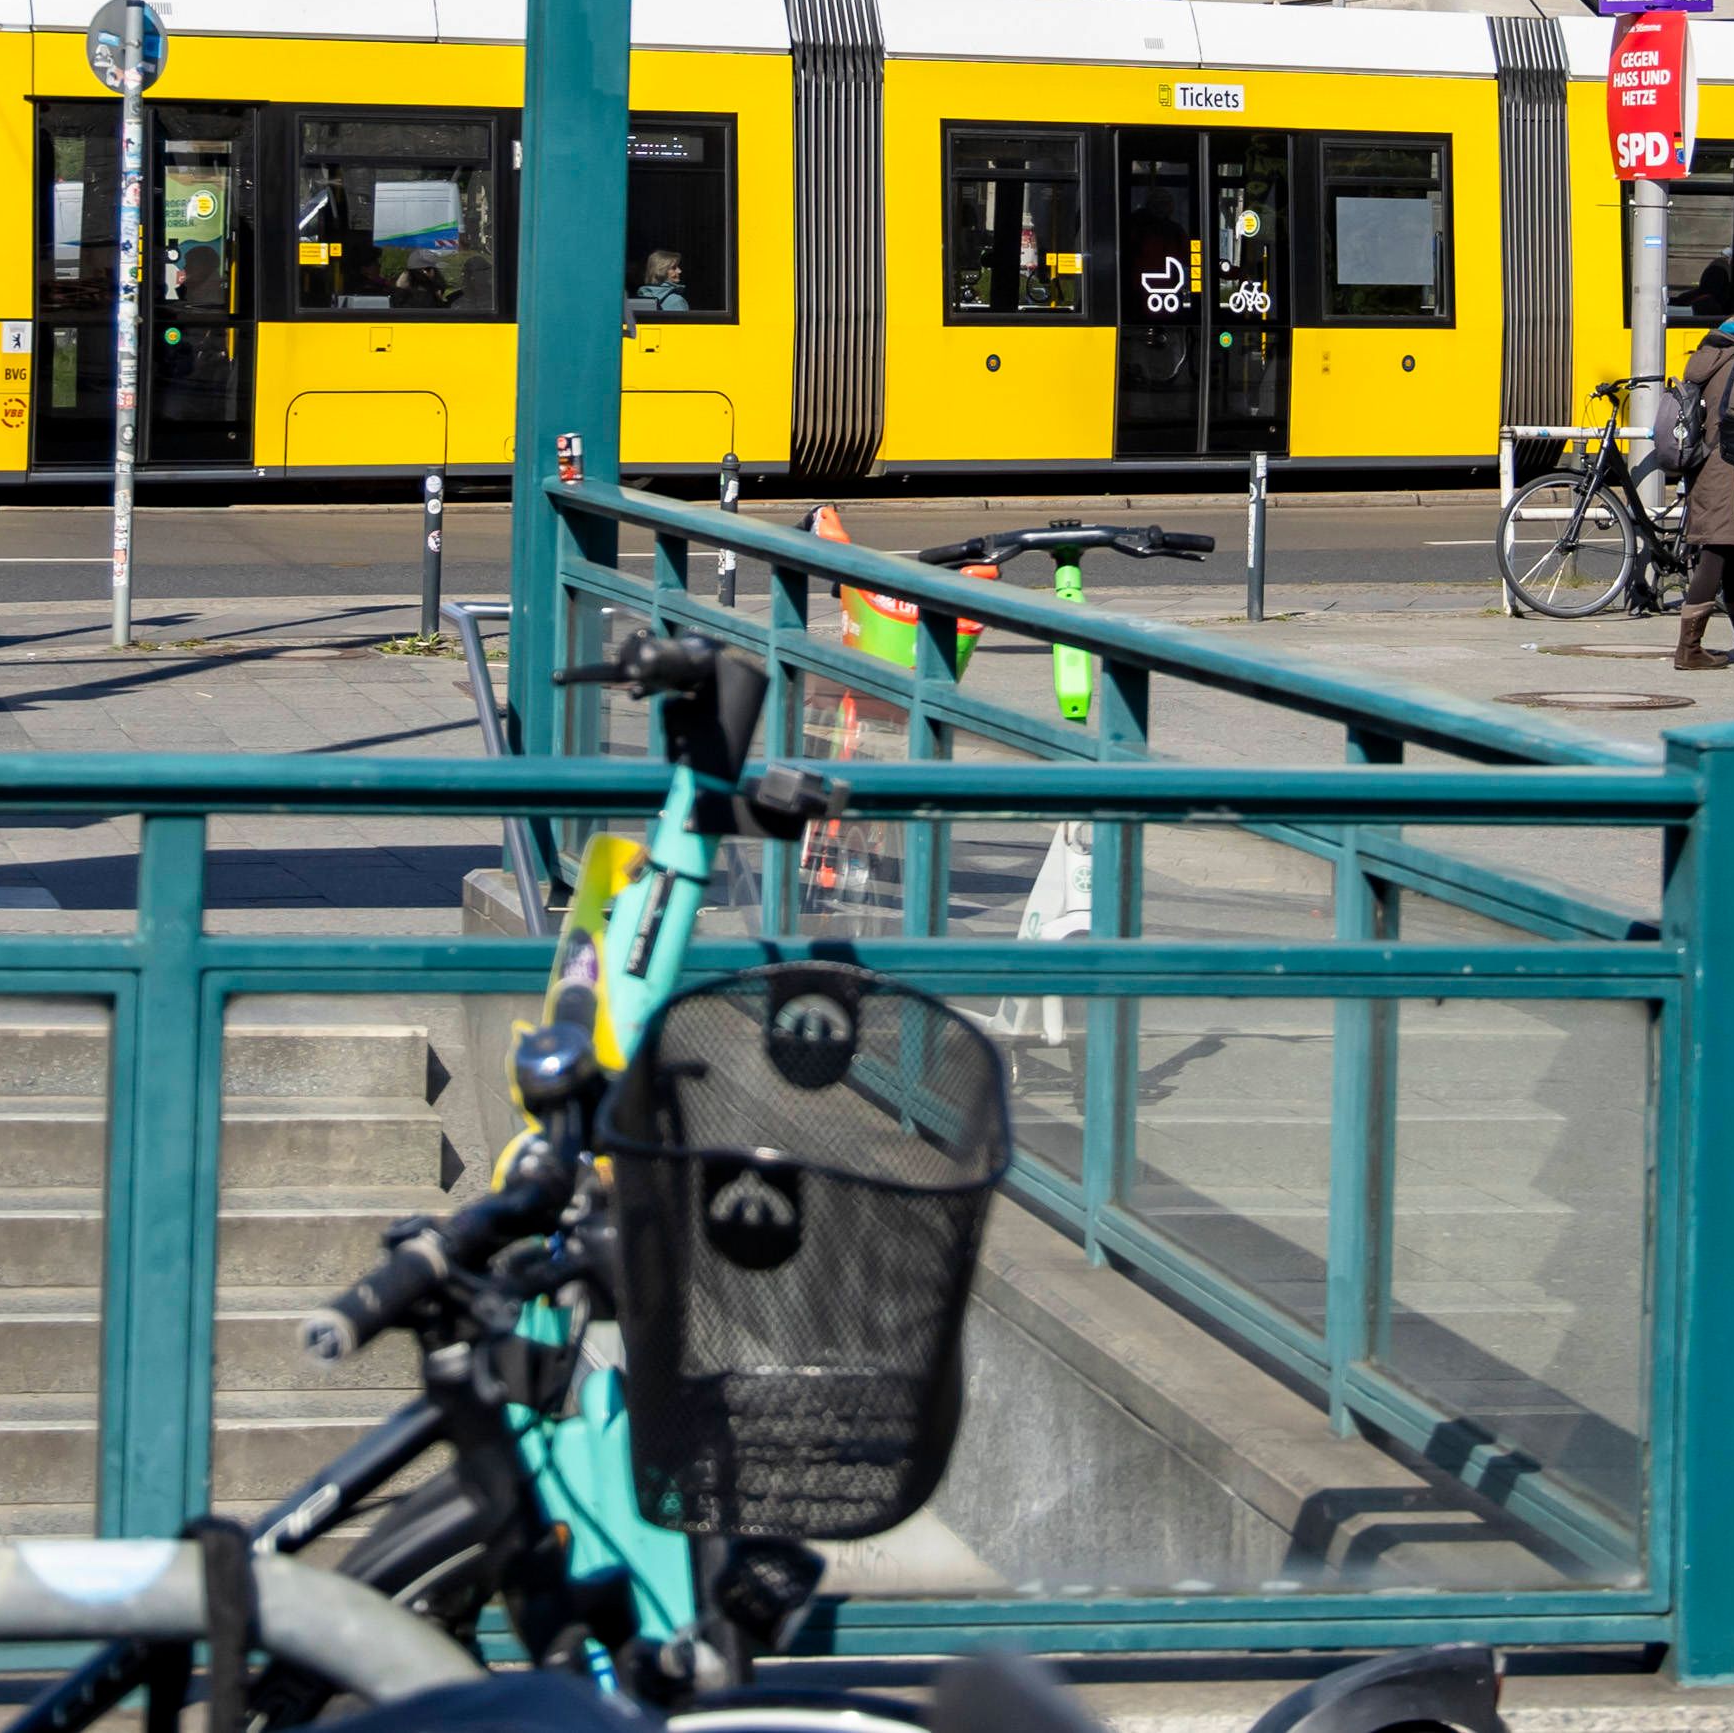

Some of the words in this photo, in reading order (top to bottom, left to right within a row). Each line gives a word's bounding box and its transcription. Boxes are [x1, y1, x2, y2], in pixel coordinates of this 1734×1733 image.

[1620, 50, 1660, 69] GEGEN
[1613, 70, 1640, 88] HASS
[1641, 69, 1671, 86] UND
[1179, 86, 1240, 109] Tickets
[1621, 89, 1657, 106] HETZE
[1616, 131, 1670, 168] SPD
[4, 367, 27, 381] BVG
[4, 408, 24, 418] VBB
